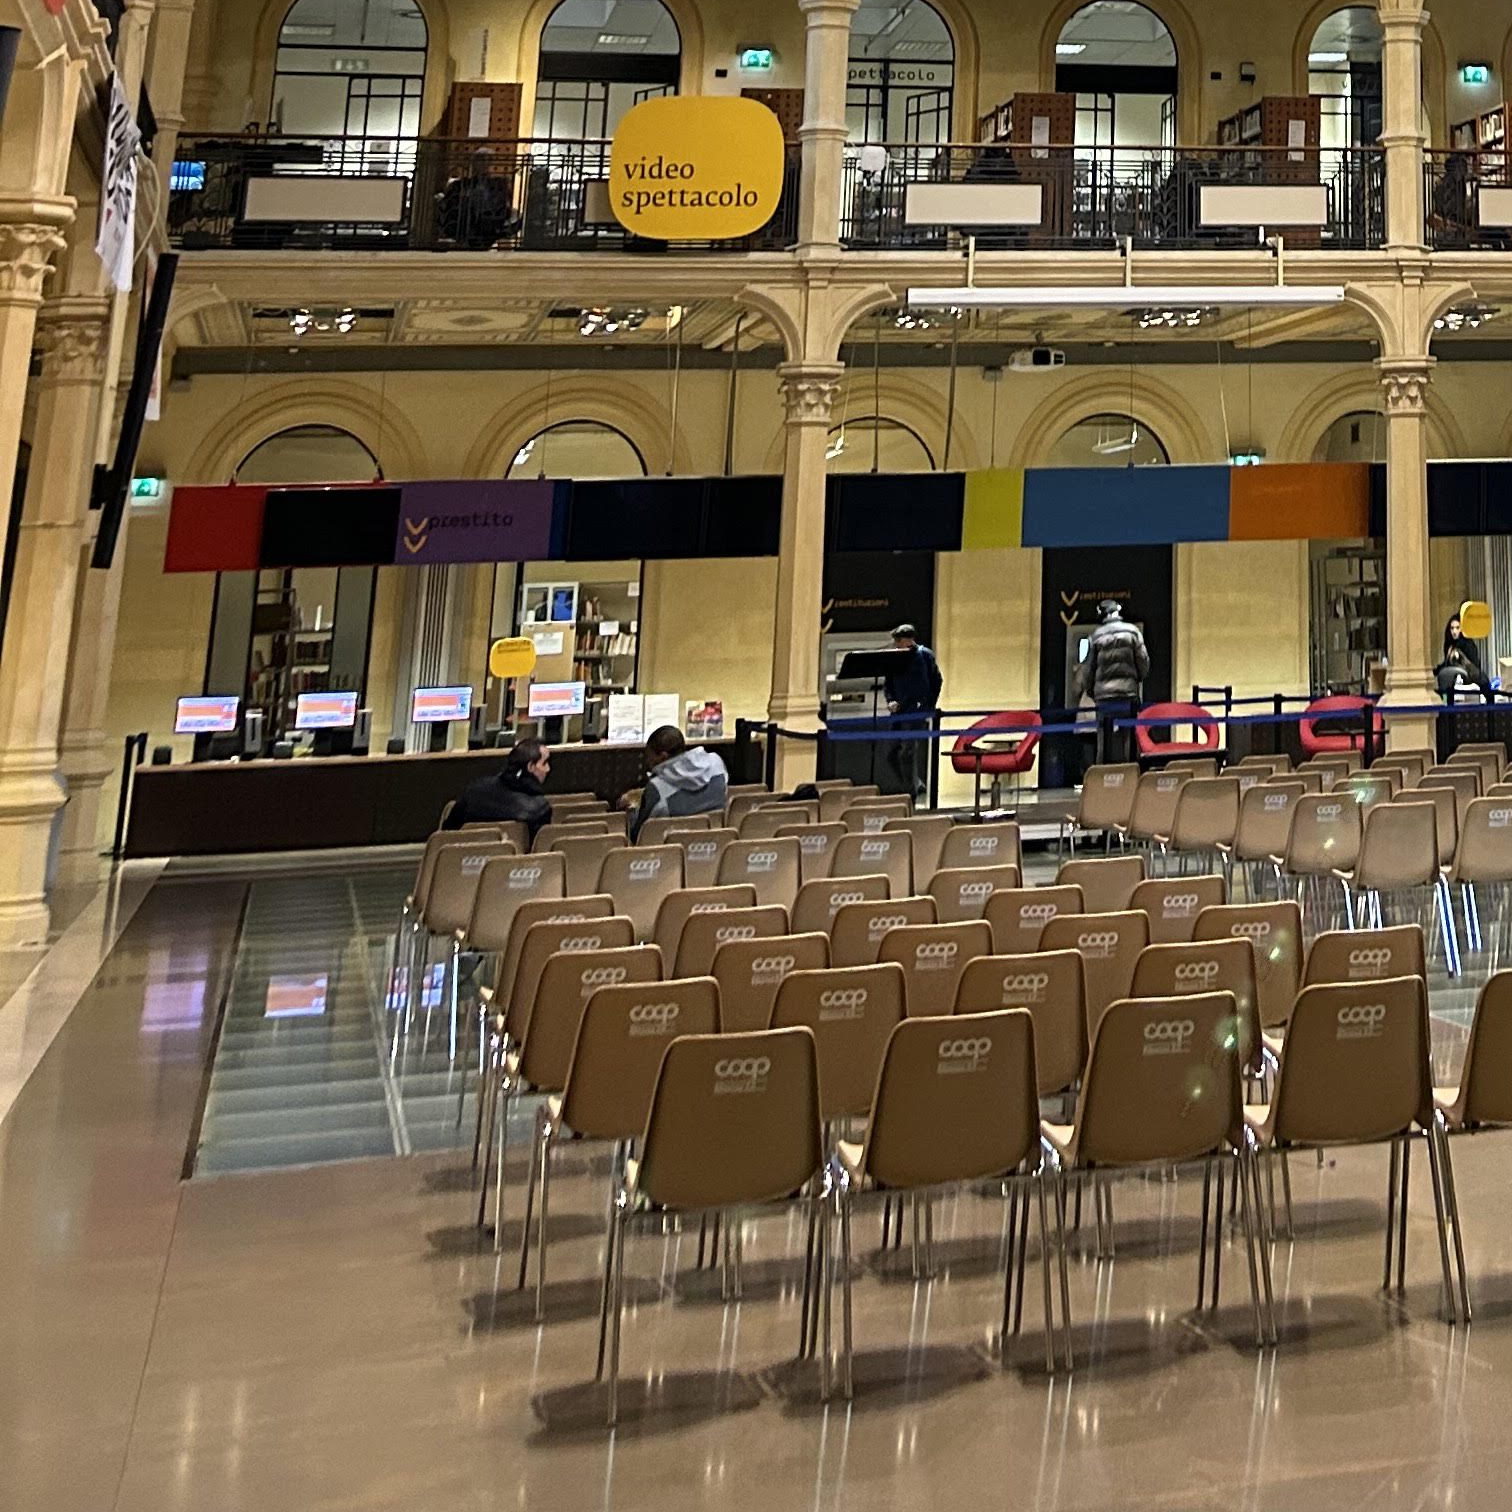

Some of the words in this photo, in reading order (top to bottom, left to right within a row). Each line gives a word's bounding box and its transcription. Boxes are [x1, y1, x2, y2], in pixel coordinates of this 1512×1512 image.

[624, 156, 695, 180] video
[621, 183, 758, 215] spettacolo
[428, 512, 514, 532] prestito
[630, 858, 660, 873] coop
[747, 852, 777, 865] coop
[509, 866, 541, 882] coop
[960, 883, 994, 897] coop
[830, 892, 864, 906] coop
[1163, 895, 1198, 910] coop
[1020, 904, 1056, 919] coop
[869, 916, 907, 931] coop
[1231, 922, 1270, 938] coop
[716, 926, 755, 942] coop
[1079, 932, 1118, 949] coop
[560, 936, 601, 952] coop
[916, 943, 958, 960] coop
[752, 956, 795, 975] coop
[1350, 949, 1391, 965] coop
[582, 968, 626, 987] coop
[1176, 961, 1219, 979] coop
[1003, 973, 1048, 992] coop
[820, 989, 868, 1009] coop
[630, 1003, 679, 1024] coop
[1337, 1004, 1386, 1027] coop
[1144, 1020, 1194, 1043] coop
[938, 1038, 991, 1059] coop
[715, 1057, 770, 1079] coop
